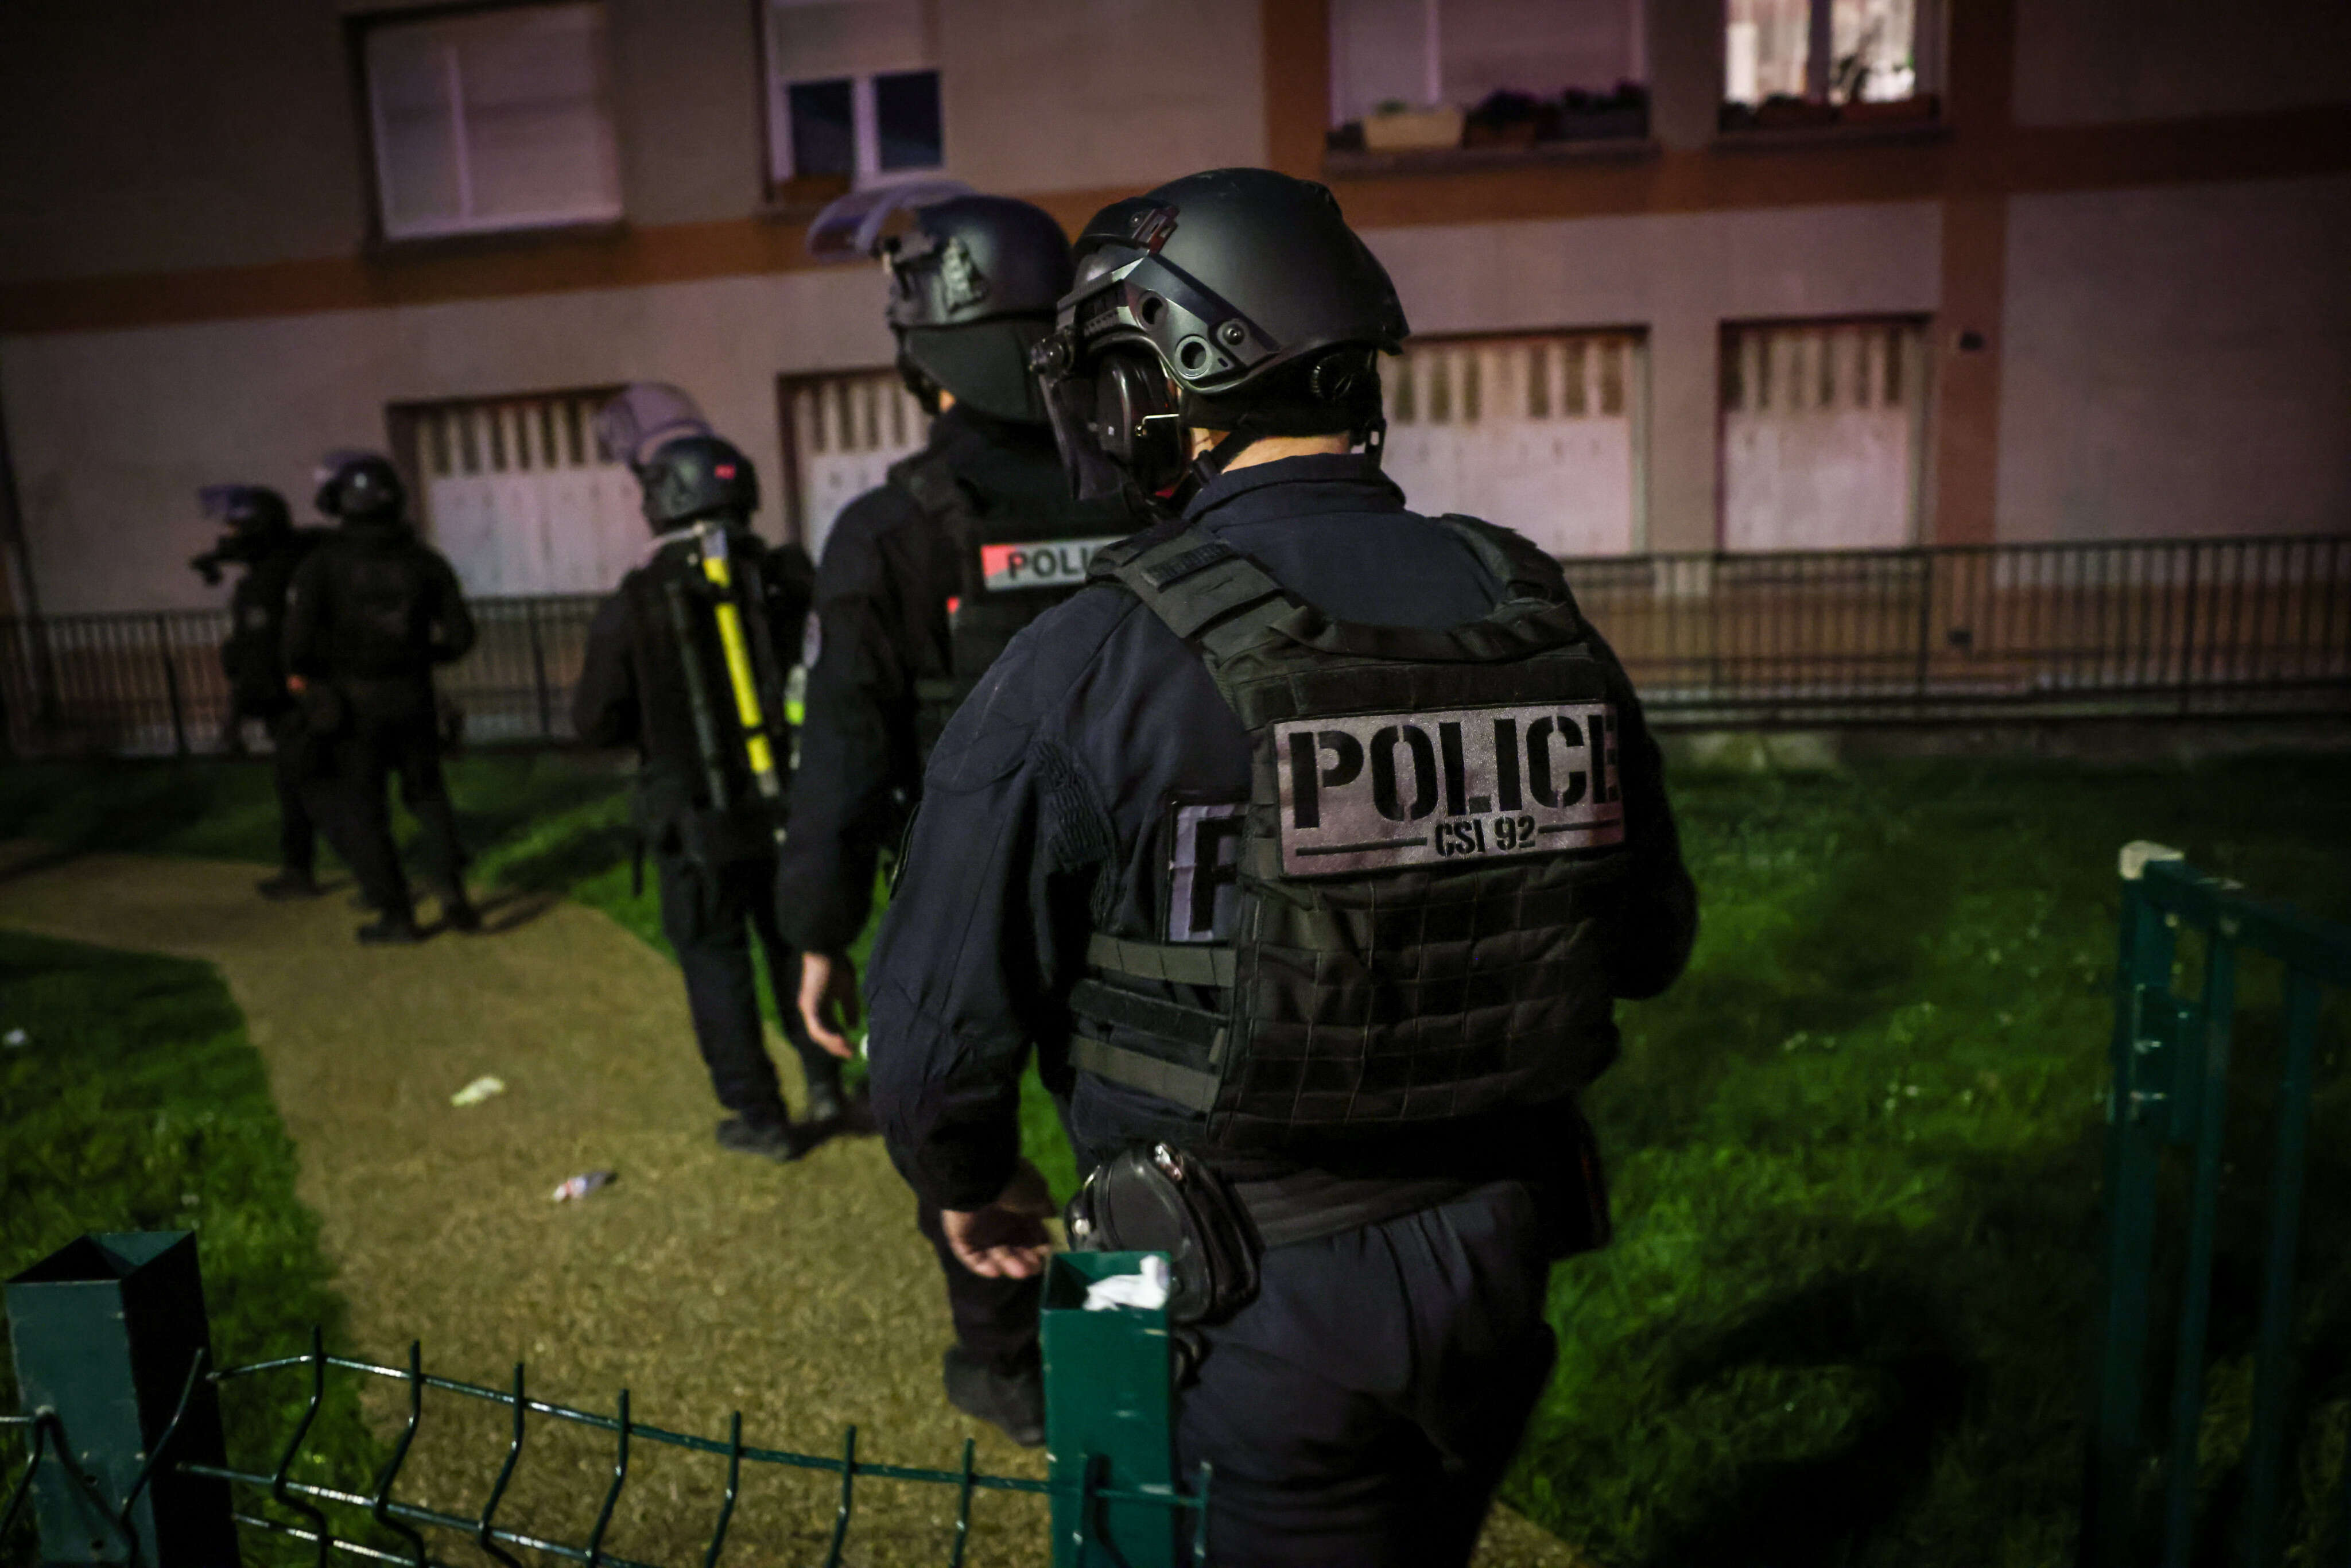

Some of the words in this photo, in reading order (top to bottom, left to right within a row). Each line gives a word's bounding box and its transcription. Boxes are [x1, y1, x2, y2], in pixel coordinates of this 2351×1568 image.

[1008, 547, 1088, 579] POLI
[1436, 819, 1485, 857] CSI
[1495, 816, 1535, 851] 92
